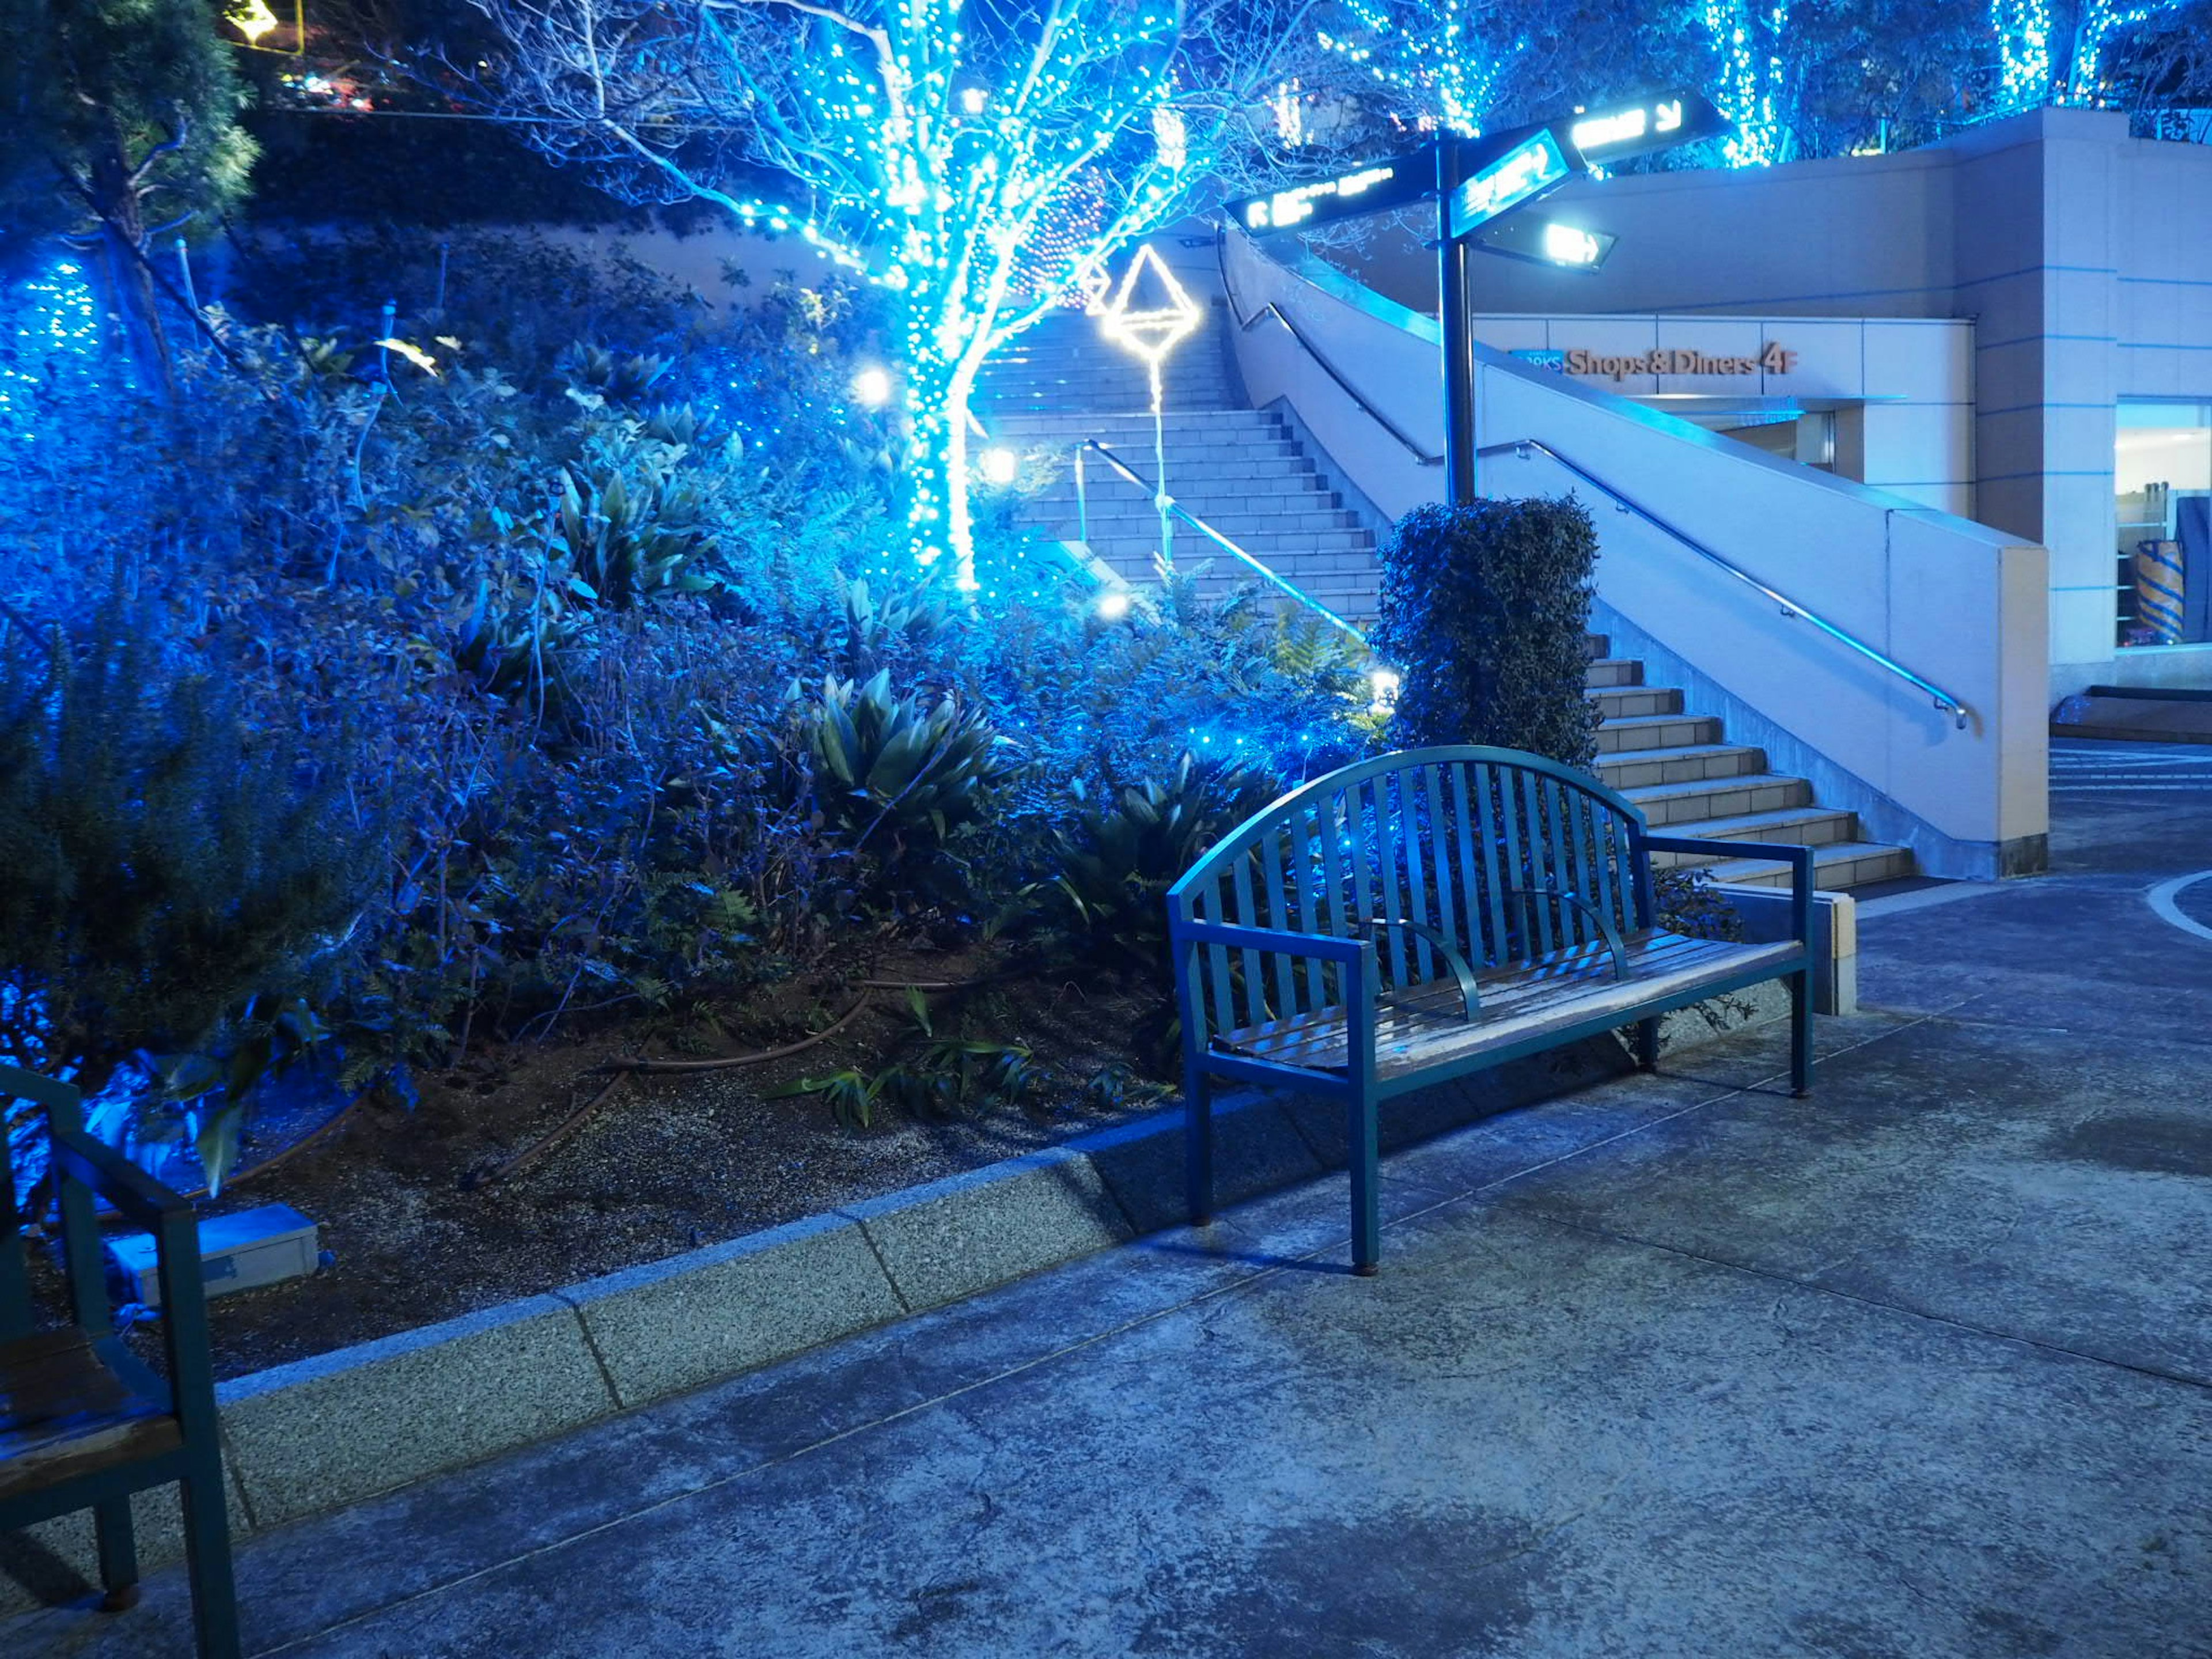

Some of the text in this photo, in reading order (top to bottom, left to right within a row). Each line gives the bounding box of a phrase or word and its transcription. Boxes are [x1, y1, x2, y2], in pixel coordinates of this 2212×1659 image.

[1567, 340, 1798, 381] Shops & Diners 4F
